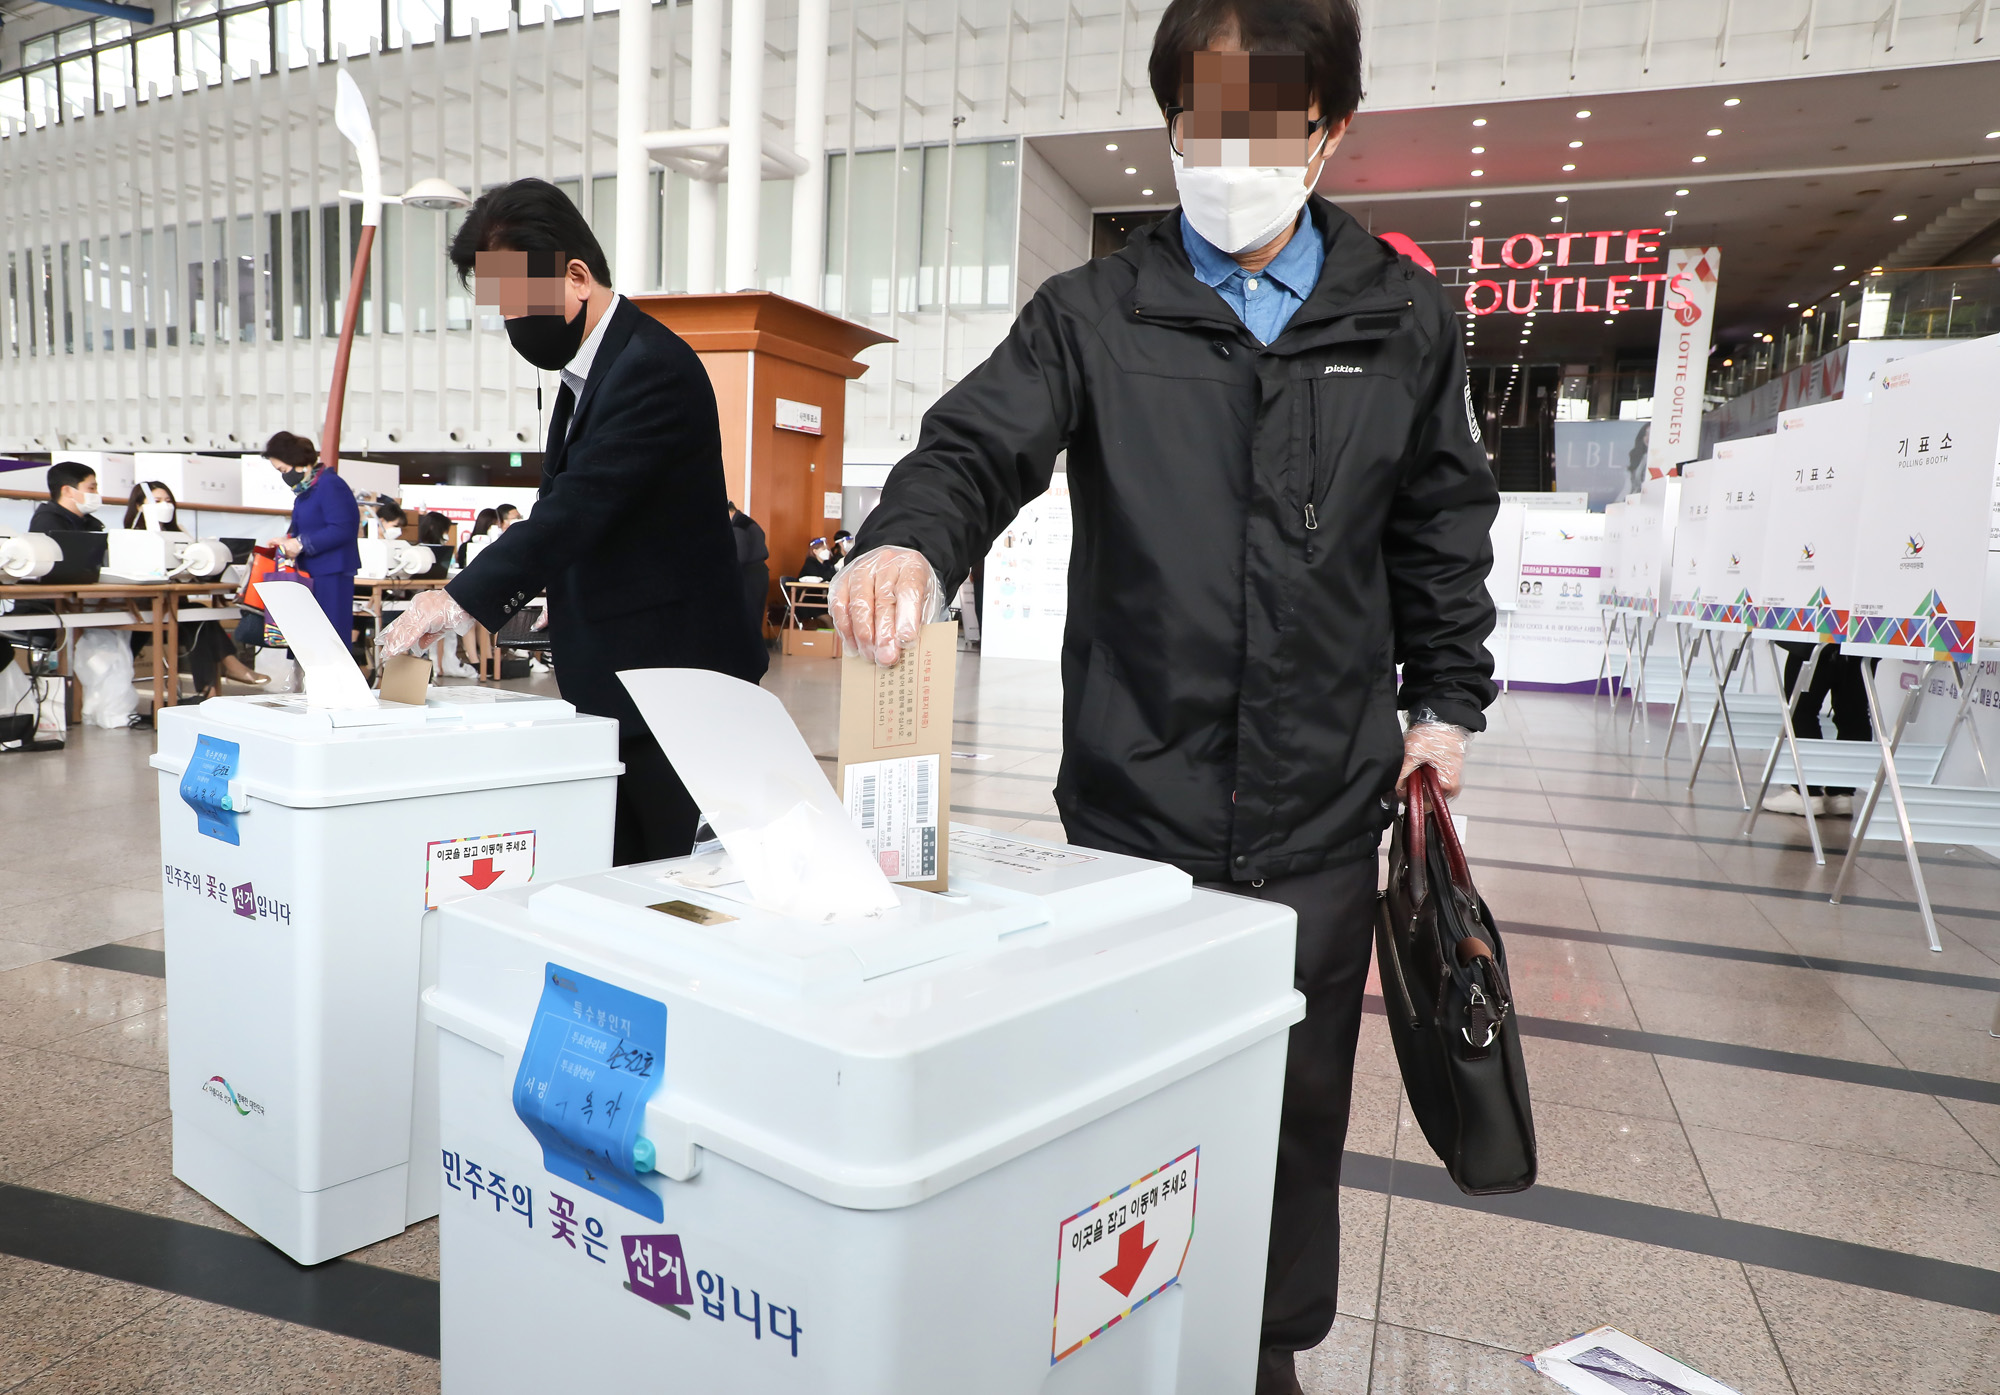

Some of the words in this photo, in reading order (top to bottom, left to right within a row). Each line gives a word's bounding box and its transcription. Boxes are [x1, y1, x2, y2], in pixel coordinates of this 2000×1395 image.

[1470, 228, 1663, 270] LOTTE
[1464, 272, 1694, 316] OUTLETS
[1675, 332, 1691, 382] LOTTE
[1668, 386, 1688, 446] OUTLETS
[1566, 441, 1623, 469] LBL
[1898, 458, 1923, 469] POLLING
[1925, 454, 1949, 465] BOOTH
[1523, 566, 1542, 574] 표하실
[907, 652, 915, 684] 표용지에
[923, 650, 932, 682] 사전투표
[920, 685, 930, 710] (투표지
[920, 711, 929, 729] 재중)
[437, 848, 460, 861] 이곳을
[463, 847, 478, 858] 잡고
[481, 843, 503, 855] 이동해
[506, 840, 527, 852] 주세요
[165, 865, 202, 895] 민주주의
[206, 874, 228, 904] 꽃은
[234, 886, 291, 926] 선거입니다
[572, 1000, 632, 1037] 특수봉인지
[571, 1031, 607, 1054] 투표관리관
[560, 1059, 596, 1083] 투표참관인
[1072, 1218, 1103, 1252] 이곳을
[1107, 1205, 1127, 1235] 잡고
[1130, 1186, 1159, 1218] 이동해
[1161, 1170, 1187, 1201] 주세요
[441, 1149, 533, 1228] 민주주의
[548, 1190, 608, 1264] 꽃은
[630, 1239, 802, 1357] 선거입니다
